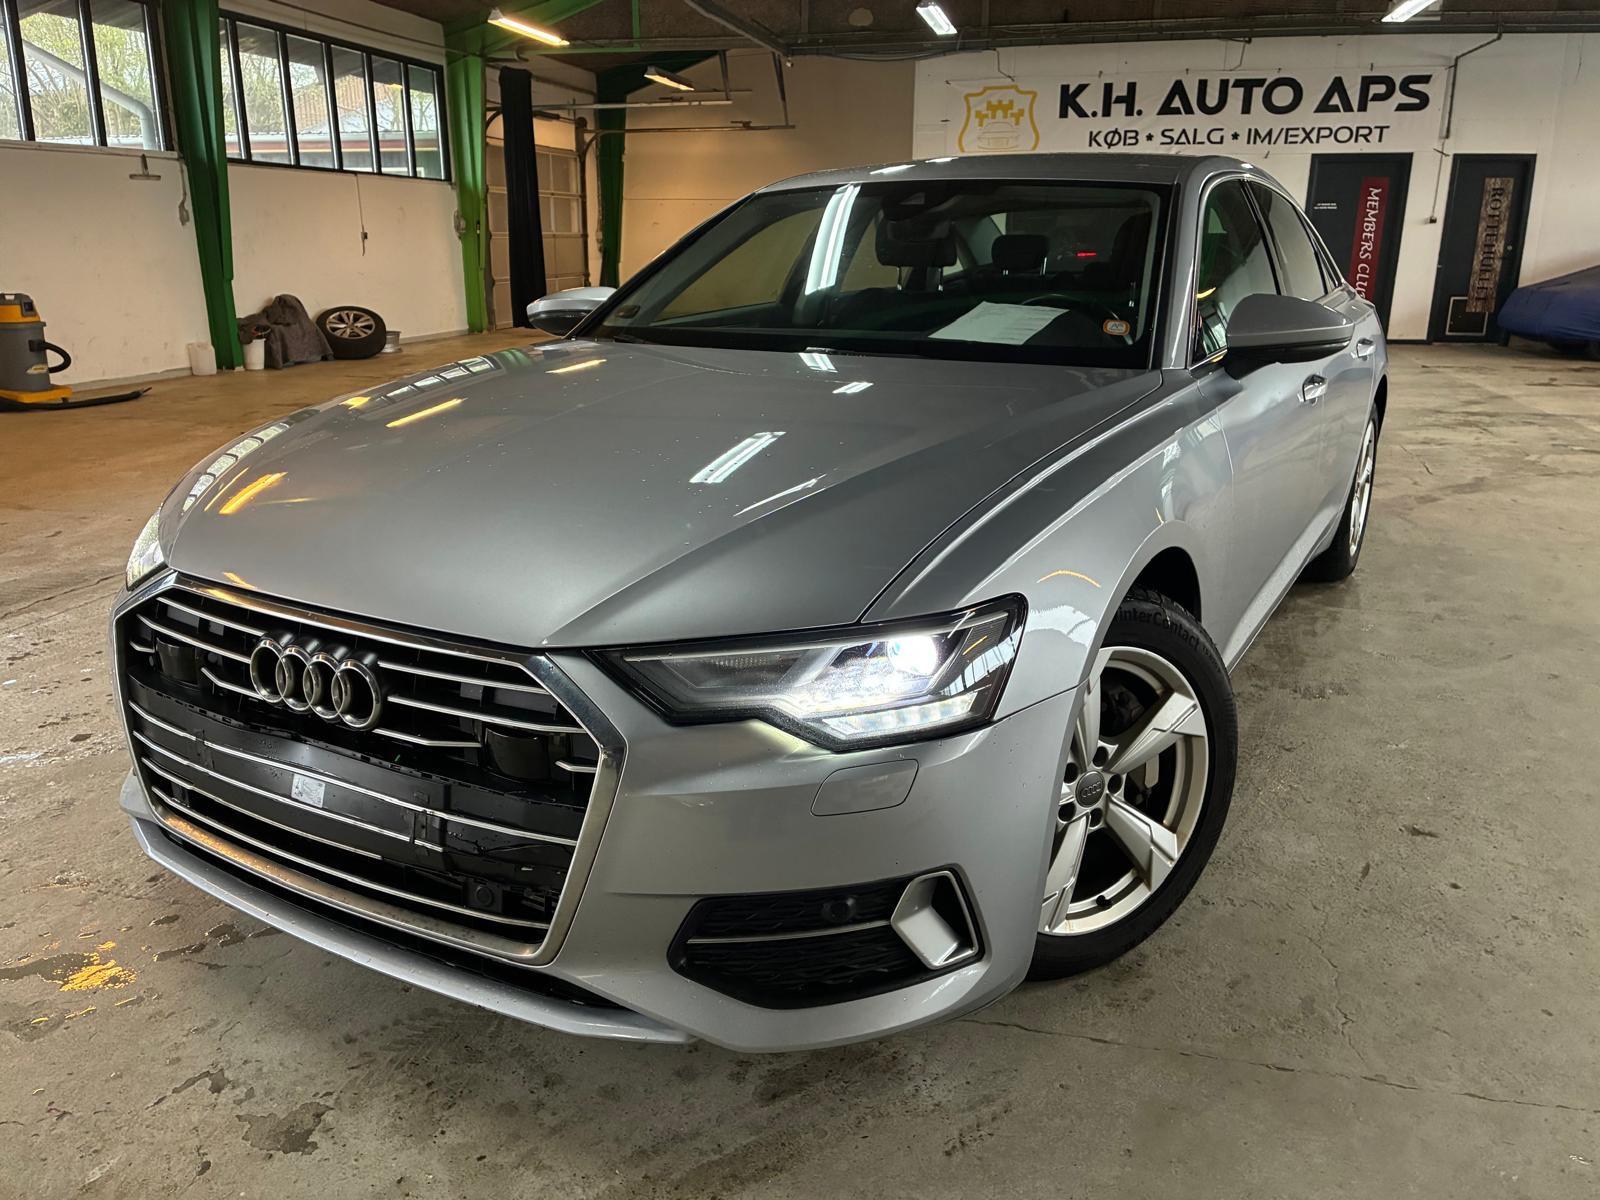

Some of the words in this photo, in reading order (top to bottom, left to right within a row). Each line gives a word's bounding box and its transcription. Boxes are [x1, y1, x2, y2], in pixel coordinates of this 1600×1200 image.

[1058, 80, 1143, 119] K.H.
[1155, 76, 1304, 116] AUTO
[1313, 74, 1433, 114] APS
[1088, 128, 1140, 150] KØB
[1159, 127, 1225, 146] SALG
[1246, 125, 1390, 145] IM/EXPORT
[1358, 187, 1382, 260] MEMBERS
